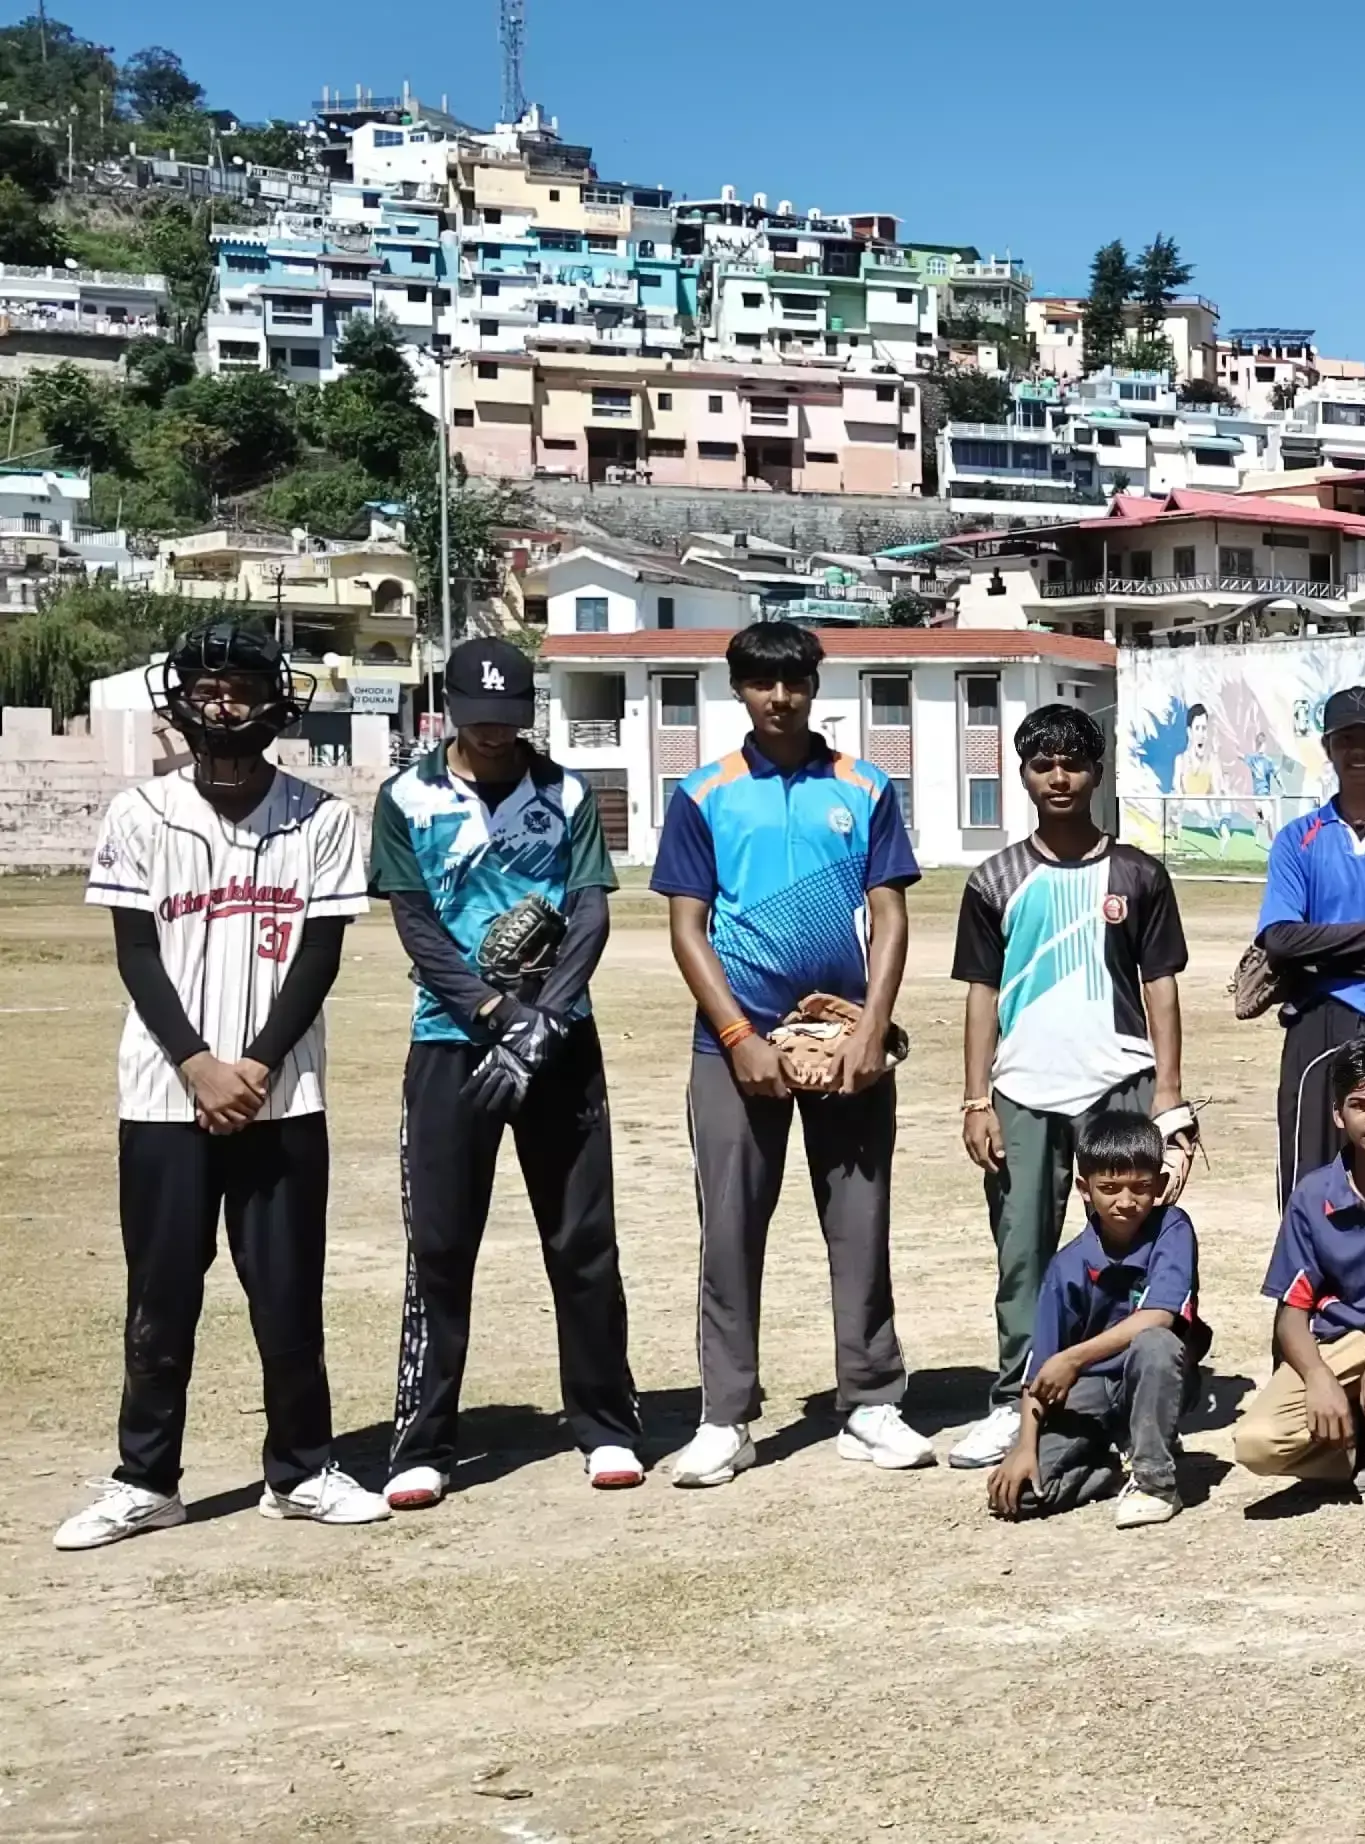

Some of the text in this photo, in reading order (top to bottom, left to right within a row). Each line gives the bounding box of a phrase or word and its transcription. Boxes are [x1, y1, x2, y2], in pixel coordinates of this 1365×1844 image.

[481, 660, 505, 690] LA
[361, 696, 394, 704] DUKAN
[257, 917, 292, 962] 31
